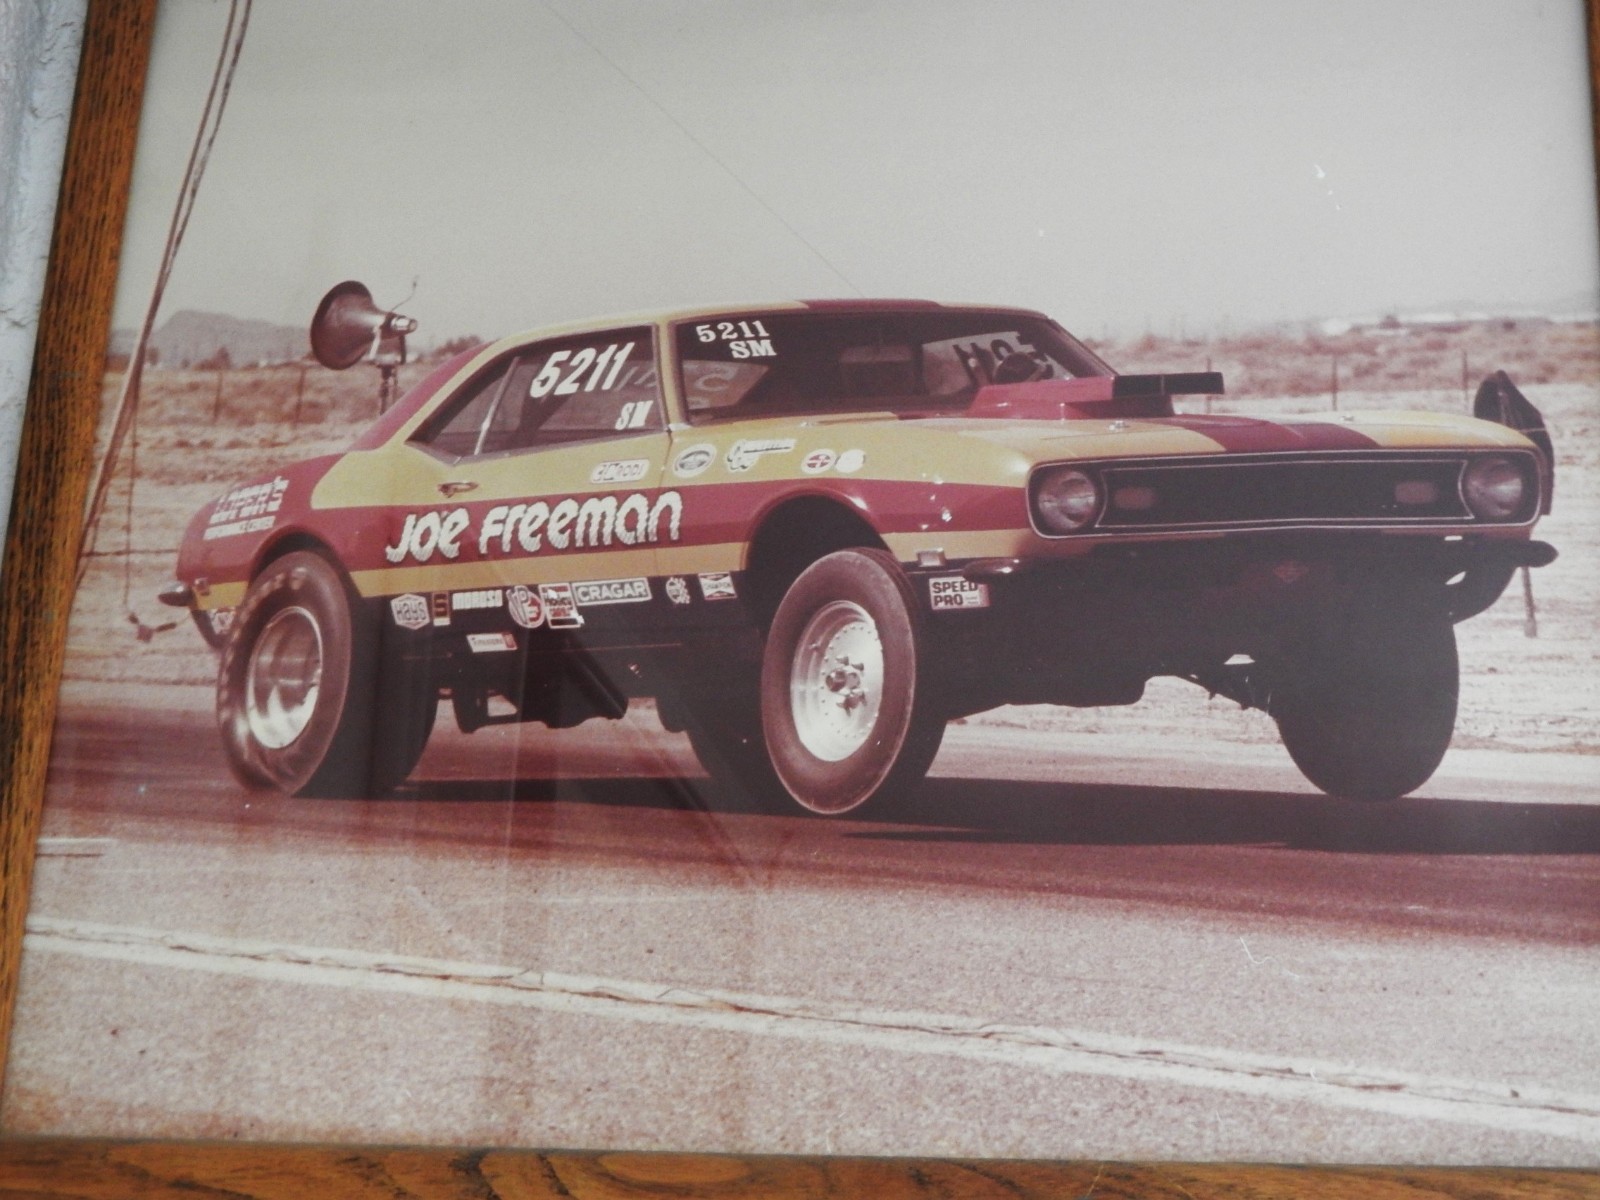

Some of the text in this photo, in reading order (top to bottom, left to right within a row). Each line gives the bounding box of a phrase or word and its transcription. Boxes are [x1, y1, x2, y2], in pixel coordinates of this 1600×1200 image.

[696, 320, 769, 343] 5211
[730, 339, 777, 360] SM
[530, 342, 635, 398] 5211
[615, 401, 653, 430] SM
[577, 581, 648, 602] CRAGAR
[932, 581, 978, 593] SPEED
[933, 593, 964, 606] PRO
